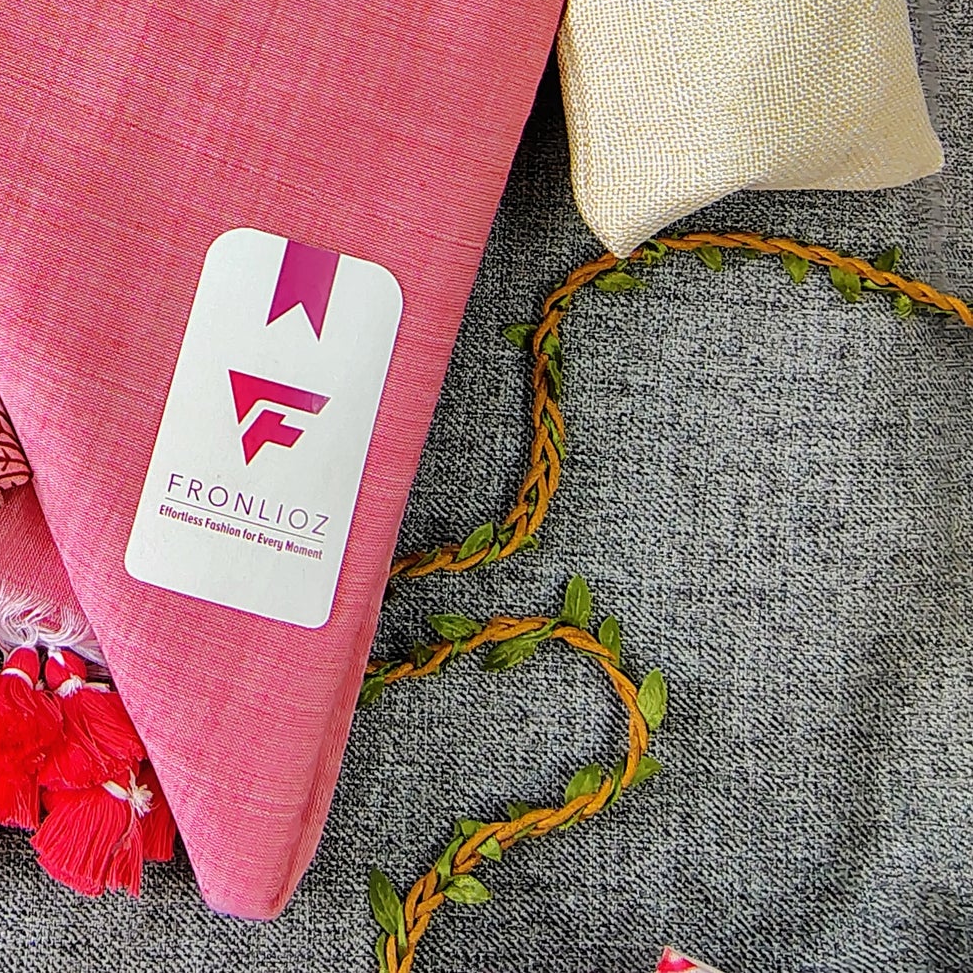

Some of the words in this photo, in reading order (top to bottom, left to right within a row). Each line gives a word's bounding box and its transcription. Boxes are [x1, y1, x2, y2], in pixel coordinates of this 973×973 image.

[159, 504, 203, 527] Effortless
[204, 516, 241, 538] Fashion
[242, 526, 256, 542] for
[257, 530, 283, 552] Every
[285, 540, 323, 560] Moment
[167, 473, 330, 537] FRONLIOZ
